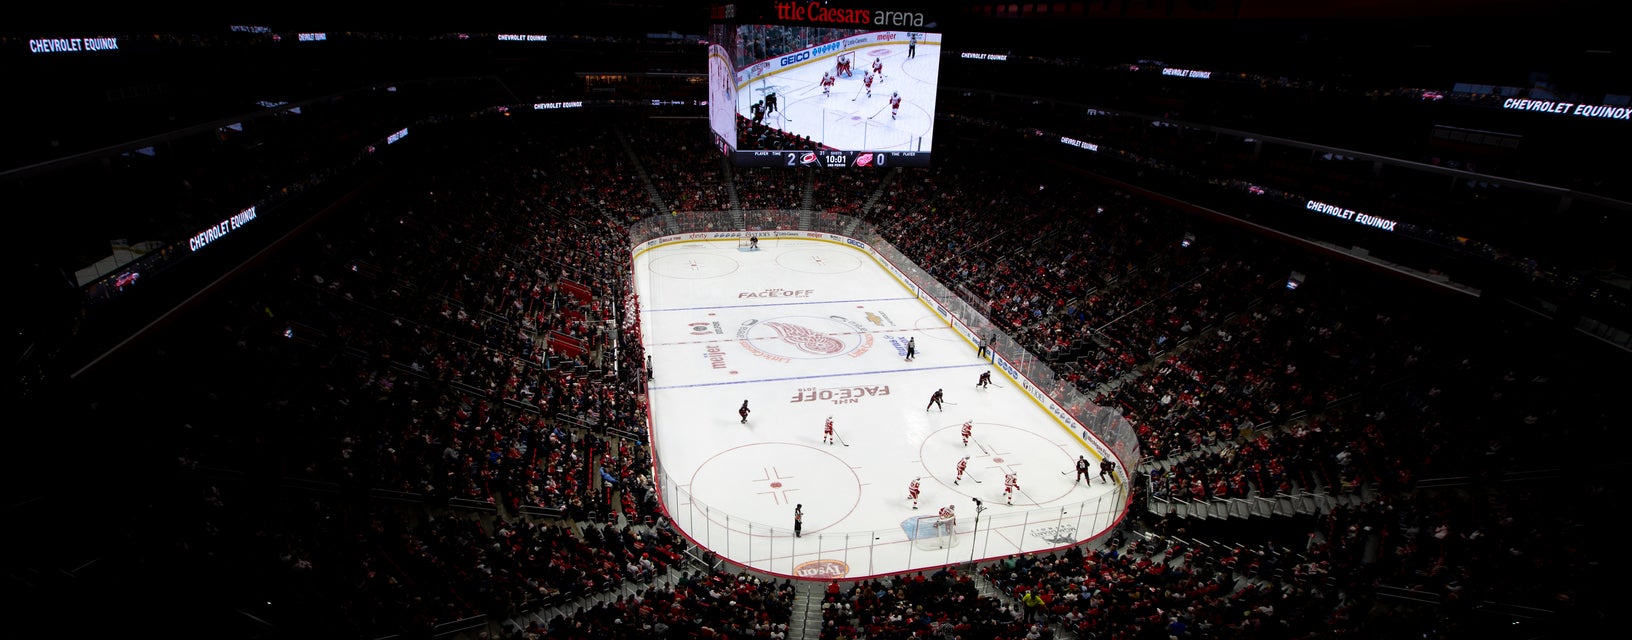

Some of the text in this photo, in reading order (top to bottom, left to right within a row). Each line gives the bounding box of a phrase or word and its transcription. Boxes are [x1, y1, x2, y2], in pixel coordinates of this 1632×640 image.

[775, 1, 924, 27] ttle Caesars arena
[29, 37, 119, 53] CHEVROLET EQUINOX
[780, 51, 810, 66] GEICO
[1503, 98, 1632, 119] CHEVROLET EQUINOX
[787, 153, 796, 166] 2
[826, 155, 846, 164] 10:01
[876, 153, 885, 166] 0
[1306, 200, 1397, 231] CHEVROLET EQUINOX
[189, 206, 257, 252] CHEVROLET EQUINOX
[689, 232, 708, 240] xfinity
[738, 289, 815, 299] FACE-OFF
[703, 345, 727, 369] meijer
[789, 385, 890, 403] FACE-OFF
[798, 563, 845, 577] Tyson
